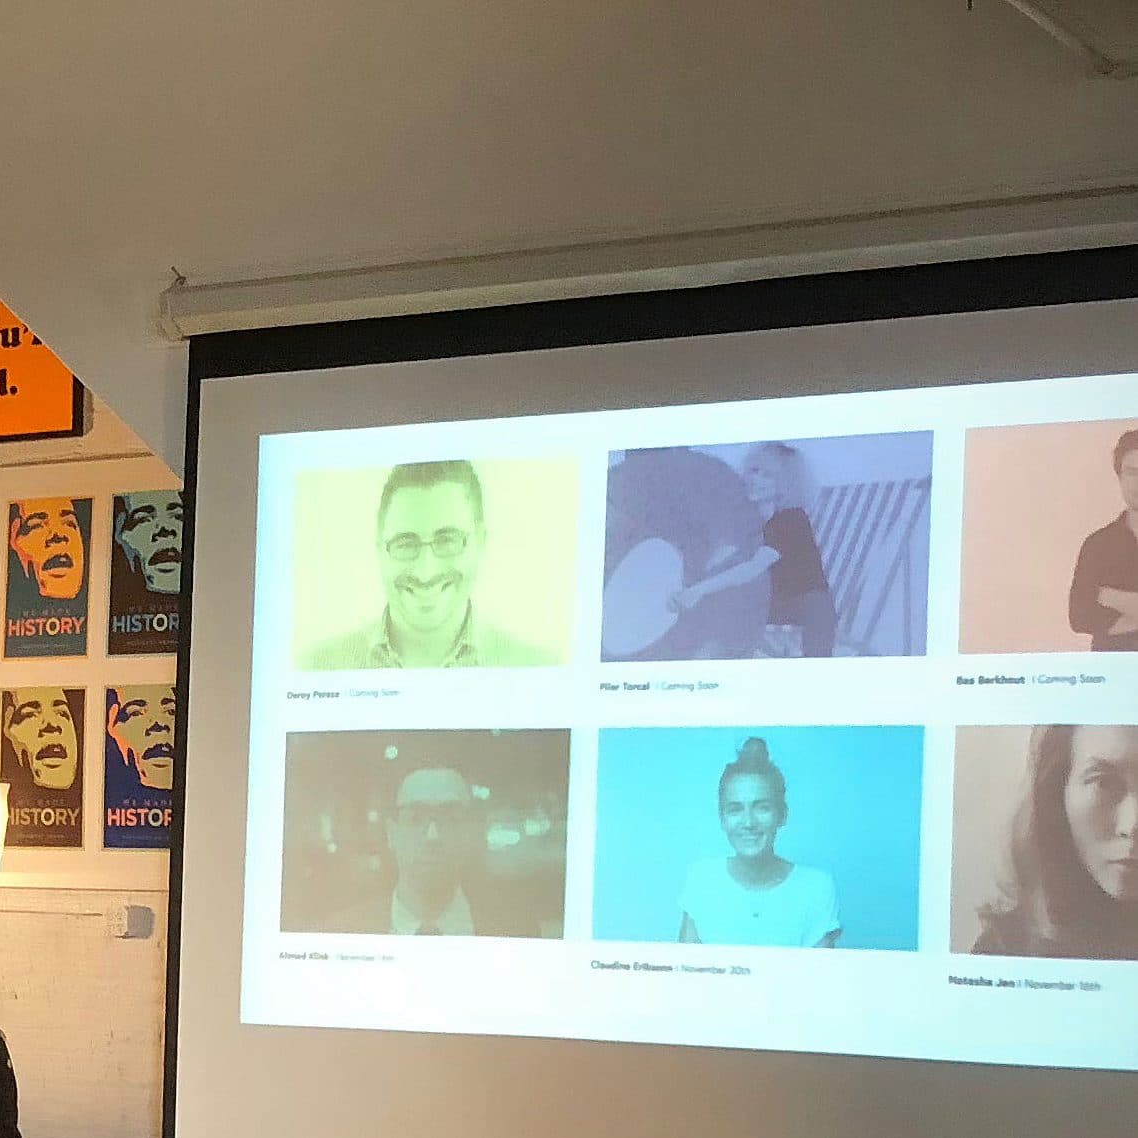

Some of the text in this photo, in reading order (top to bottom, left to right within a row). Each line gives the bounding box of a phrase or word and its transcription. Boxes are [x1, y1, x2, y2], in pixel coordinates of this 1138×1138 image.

[8, 616, 86, 637] HISTORY
[113, 613, 180, 633] HISTOR
[1079, 674, 1106, 683] Soon
[107, 808, 172, 826] HISTOR
